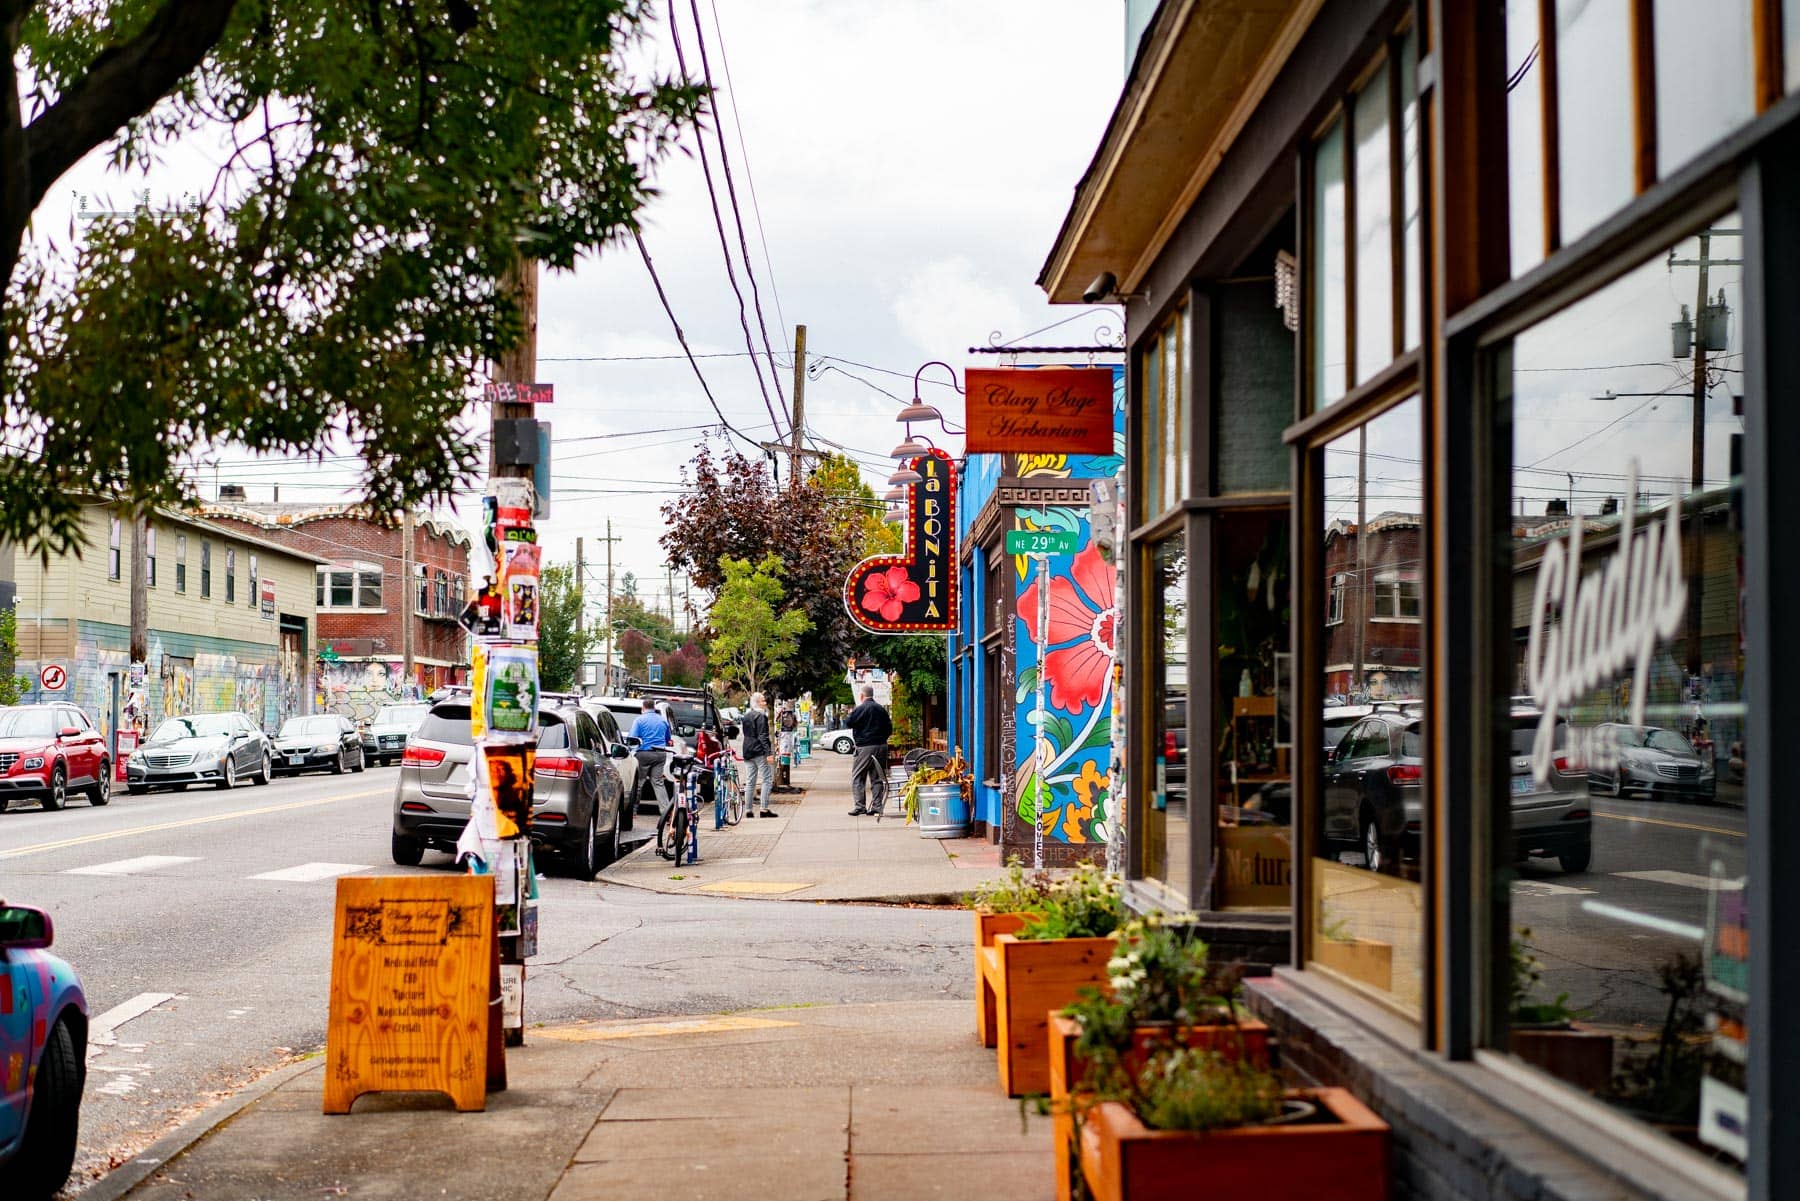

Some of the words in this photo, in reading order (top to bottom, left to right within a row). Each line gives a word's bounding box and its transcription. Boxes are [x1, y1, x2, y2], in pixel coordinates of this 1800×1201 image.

[984, 383, 1039, 415] Clary
[1046, 385, 1097, 416] Sage
[987, 415, 1089, 438] Herbarium
[1015, 540, 1025, 549] NE
[1031, 536, 1056, 550] 29th
[1528, 457, 1688, 784] Gladys
